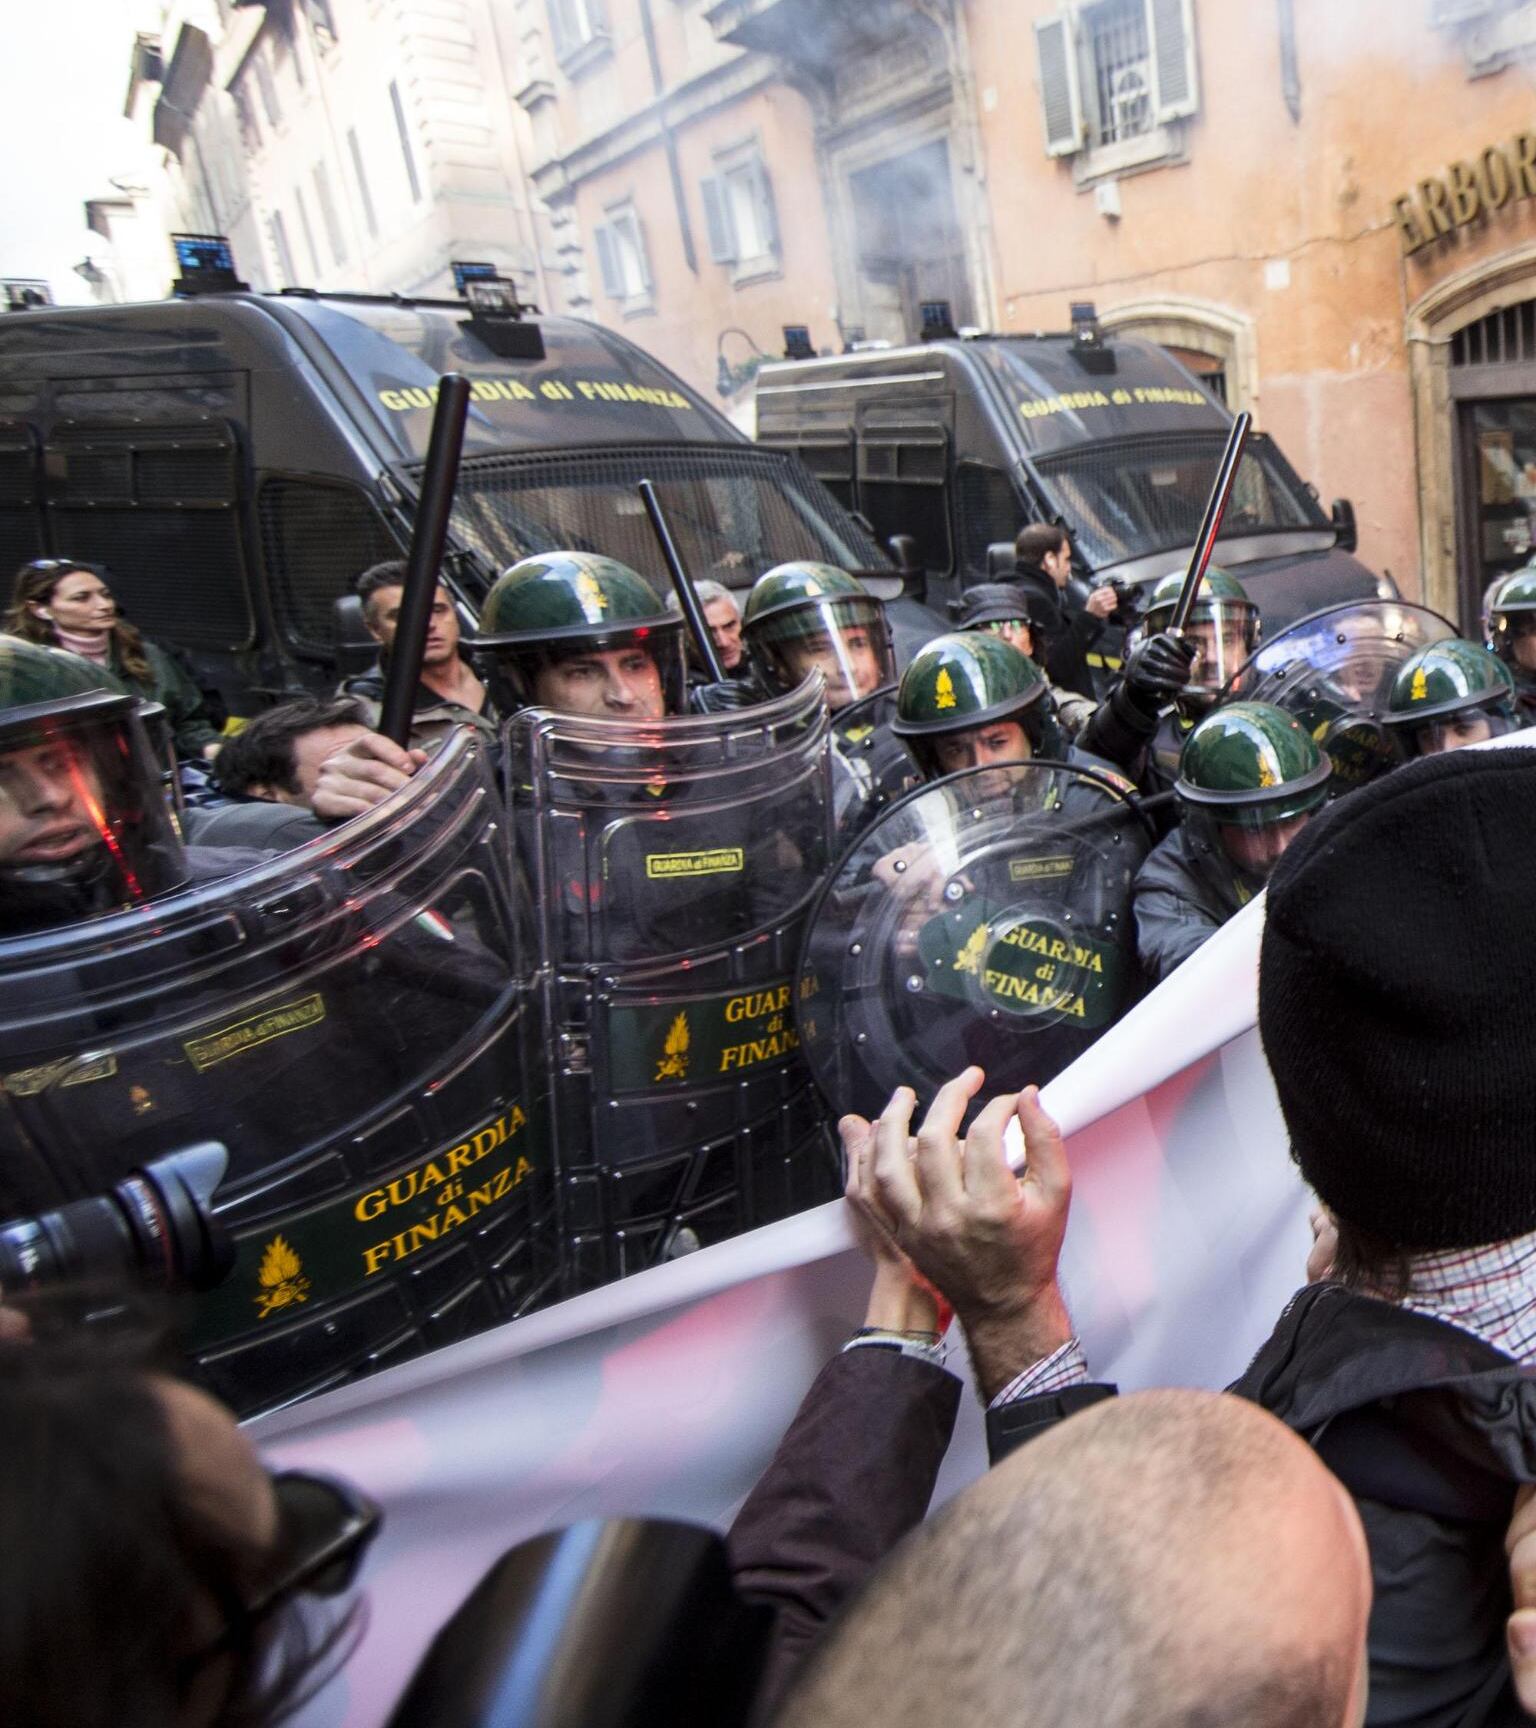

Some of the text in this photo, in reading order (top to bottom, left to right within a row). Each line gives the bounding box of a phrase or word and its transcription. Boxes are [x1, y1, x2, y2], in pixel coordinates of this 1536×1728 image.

[378, 379, 692, 411] GUDIA di FINANZA
[1020, 387, 1207, 418] GUARDIA di FINANZA
[1035, 963, 1057, 981] di
[984, 969, 1086, 1017] FINANZA
[767, 1013, 783, 1033] di
[354, 1104, 528, 1223] GUARDIA
[435, 1177, 465, 1206] di
[361, 1155, 537, 1277] FINANZA
